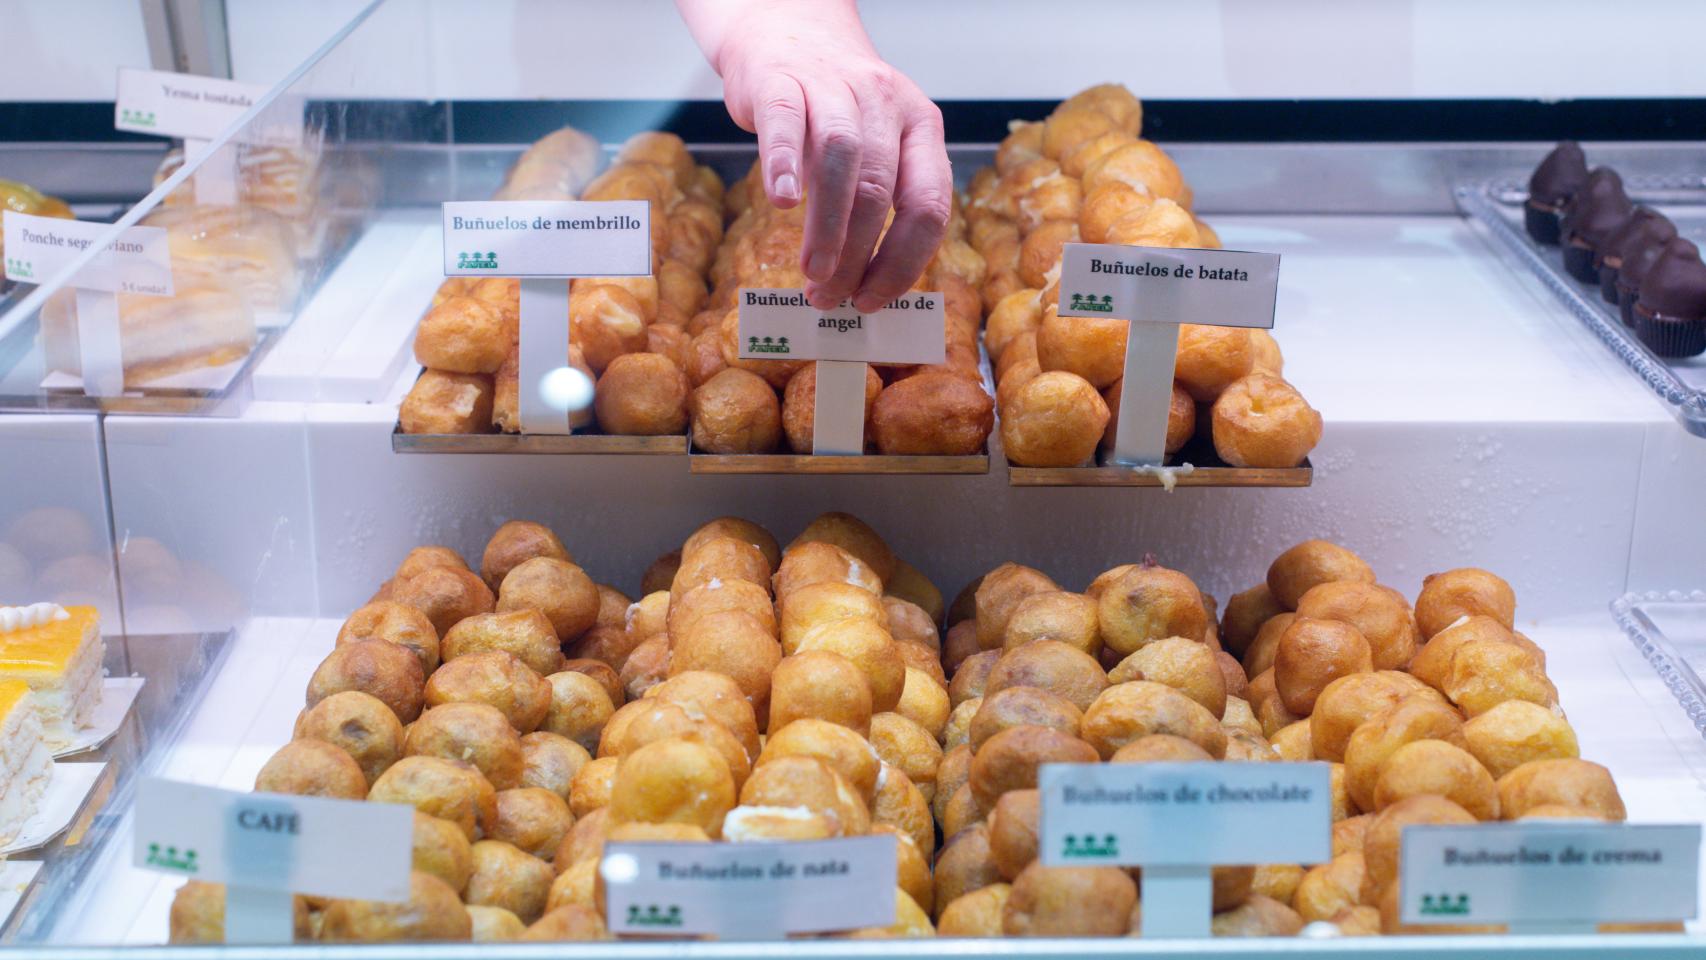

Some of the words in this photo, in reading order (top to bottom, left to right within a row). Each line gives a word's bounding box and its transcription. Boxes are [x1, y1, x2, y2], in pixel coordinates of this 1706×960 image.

[162, 85, 200, 100] Yema
[204, 91, 253, 106] tostada
[453, 215, 527, 230] Buñuelos
[532, 215, 551, 230] de
[556, 215, 641, 230] membrillo
[22, 228, 63, 246] Ponche
[1090, 258, 1168, 277] Buñuelos
[1174, 263, 1194, 279] de
[1198, 265, 1249, 281] batata
[746, 291, 812, 307] Buñuel
[914, 296, 935, 310] de
[818, 314, 862, 332] angel
[1063, 783, 1167, 804] Buñuelos
[1174, 783, 1201, 803] de
[1207, 781, 1312, 804] chocolate
[1443, 846, 1551, 866] Buñuelos
[1558, 846, 1585, 865] de
[1592, 849, 1663, 864] crema
[658, 861, 763, 880] Buñuelos
[769, 860, 796, 878] de
[803, 860, 849, 877] nata
